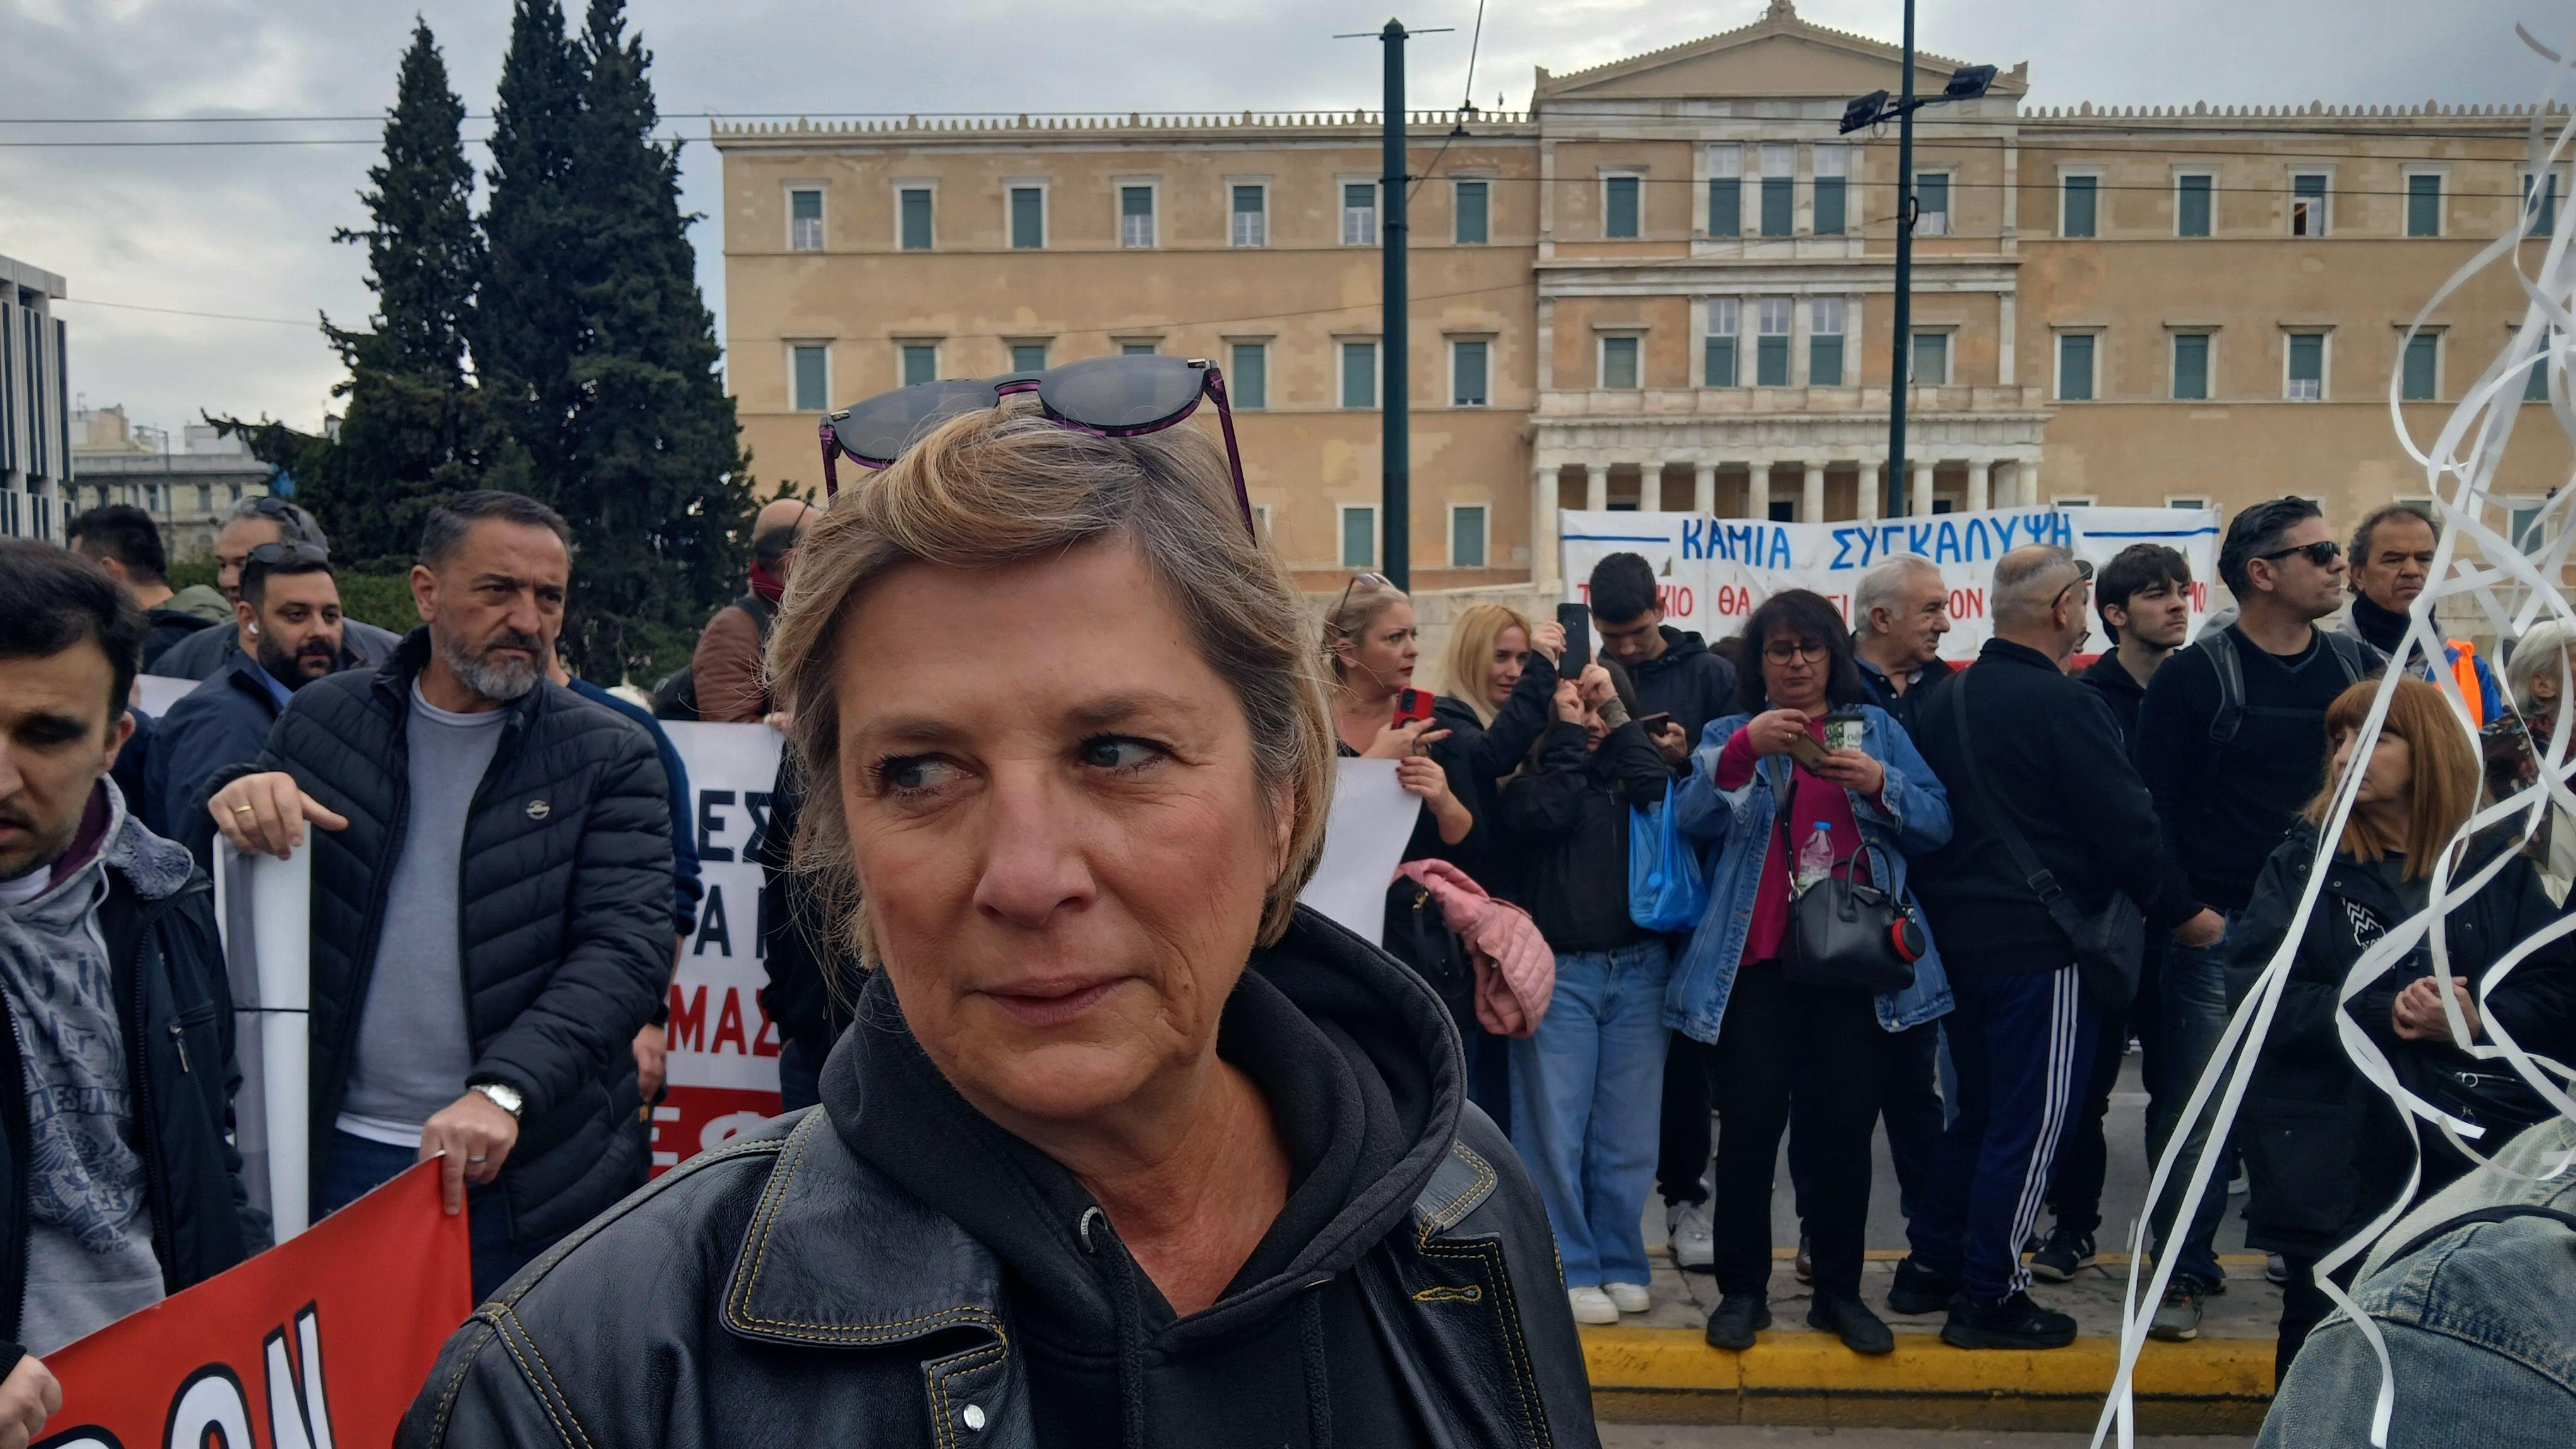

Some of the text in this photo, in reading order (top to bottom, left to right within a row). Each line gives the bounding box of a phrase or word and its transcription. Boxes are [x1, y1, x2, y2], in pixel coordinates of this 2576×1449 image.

[1683, 512, 2072, 569] ΚΑΜΙΑ ΣΥΓΚΑΛΥΨΗ
[1655, 585, 1693, 617] ΚΙΟ
[1718, 585, 1751, 617] ΘΑ
[1950, 588, 1983, 619] ΟΝ
[698, 789, 773, 864] ΕΣ
